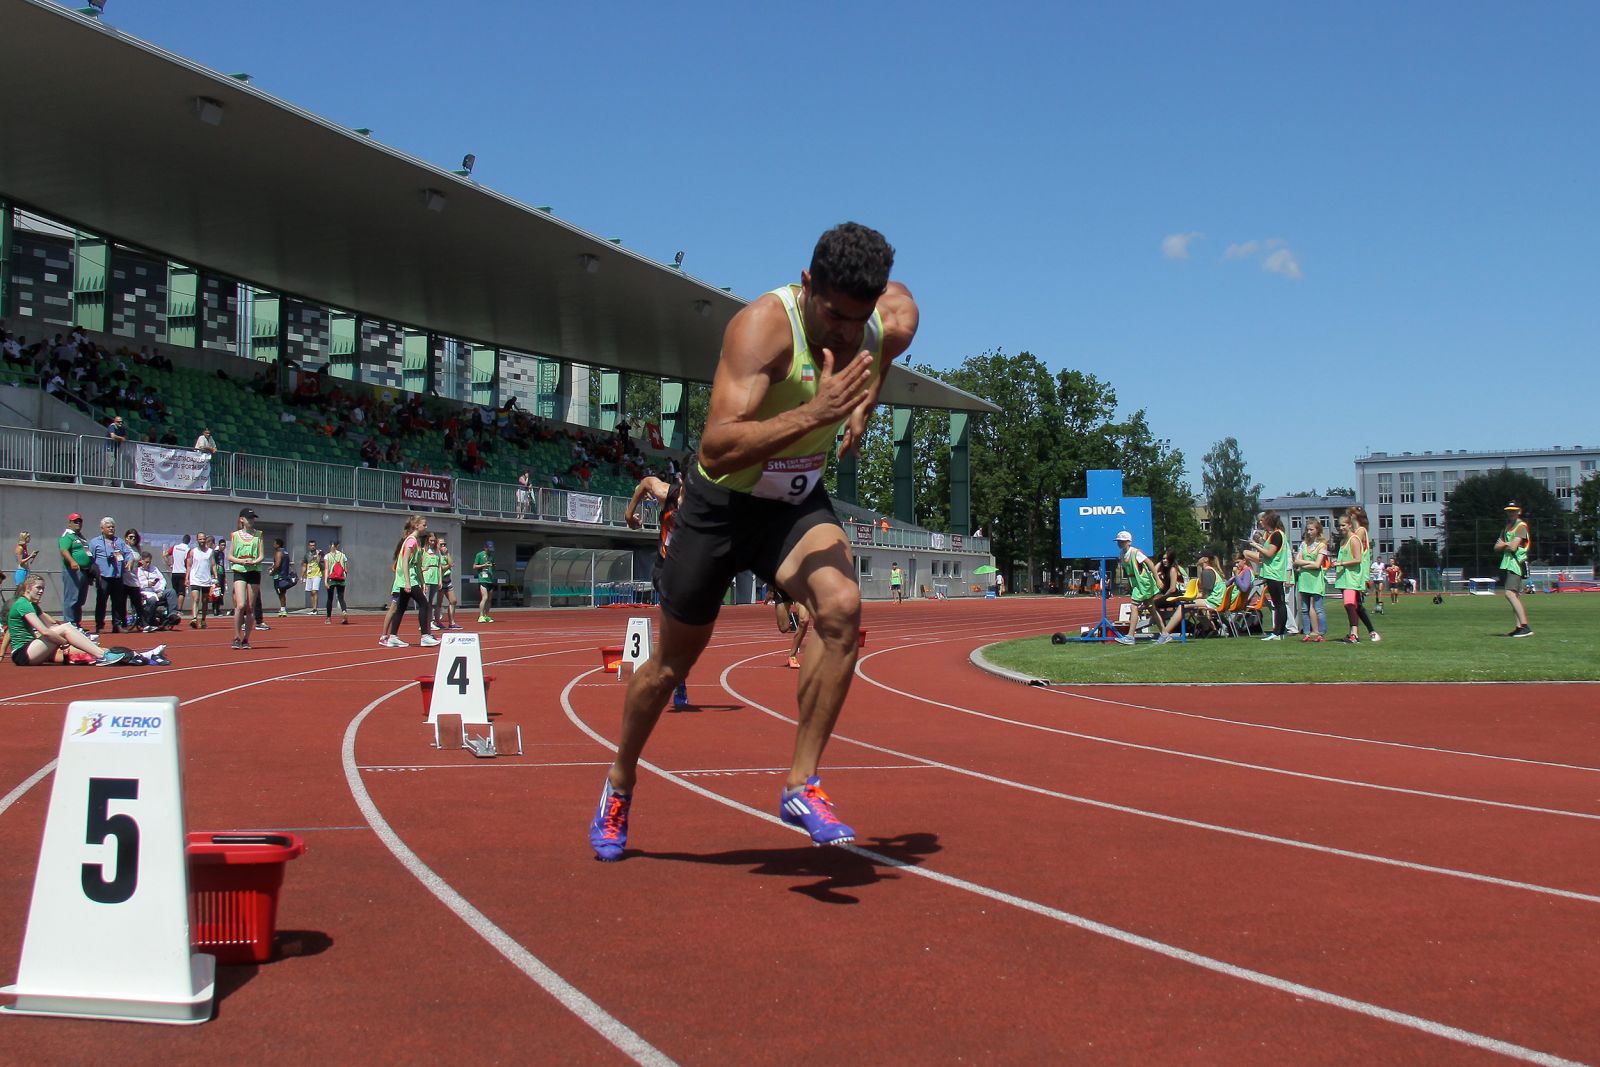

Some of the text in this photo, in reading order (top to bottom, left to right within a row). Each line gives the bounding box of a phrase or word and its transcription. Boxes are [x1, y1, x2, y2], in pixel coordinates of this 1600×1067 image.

[767, 461, 786, 470] 5th
[412, 477, 440, 489] LATVIJAS
[787, 474, 808, 496] 9
[403, 487, 449, 501] VIEGLATLĒTIKA
[1079, 505, 1126, 516] DIMA
[631, 633, 641, 658] 3
[446, 656, 470, 695] 4
[110, 716, 162, 729] KERKO
[121, 729, 148, 738] sport
[81, 777, 140, 904] 5
